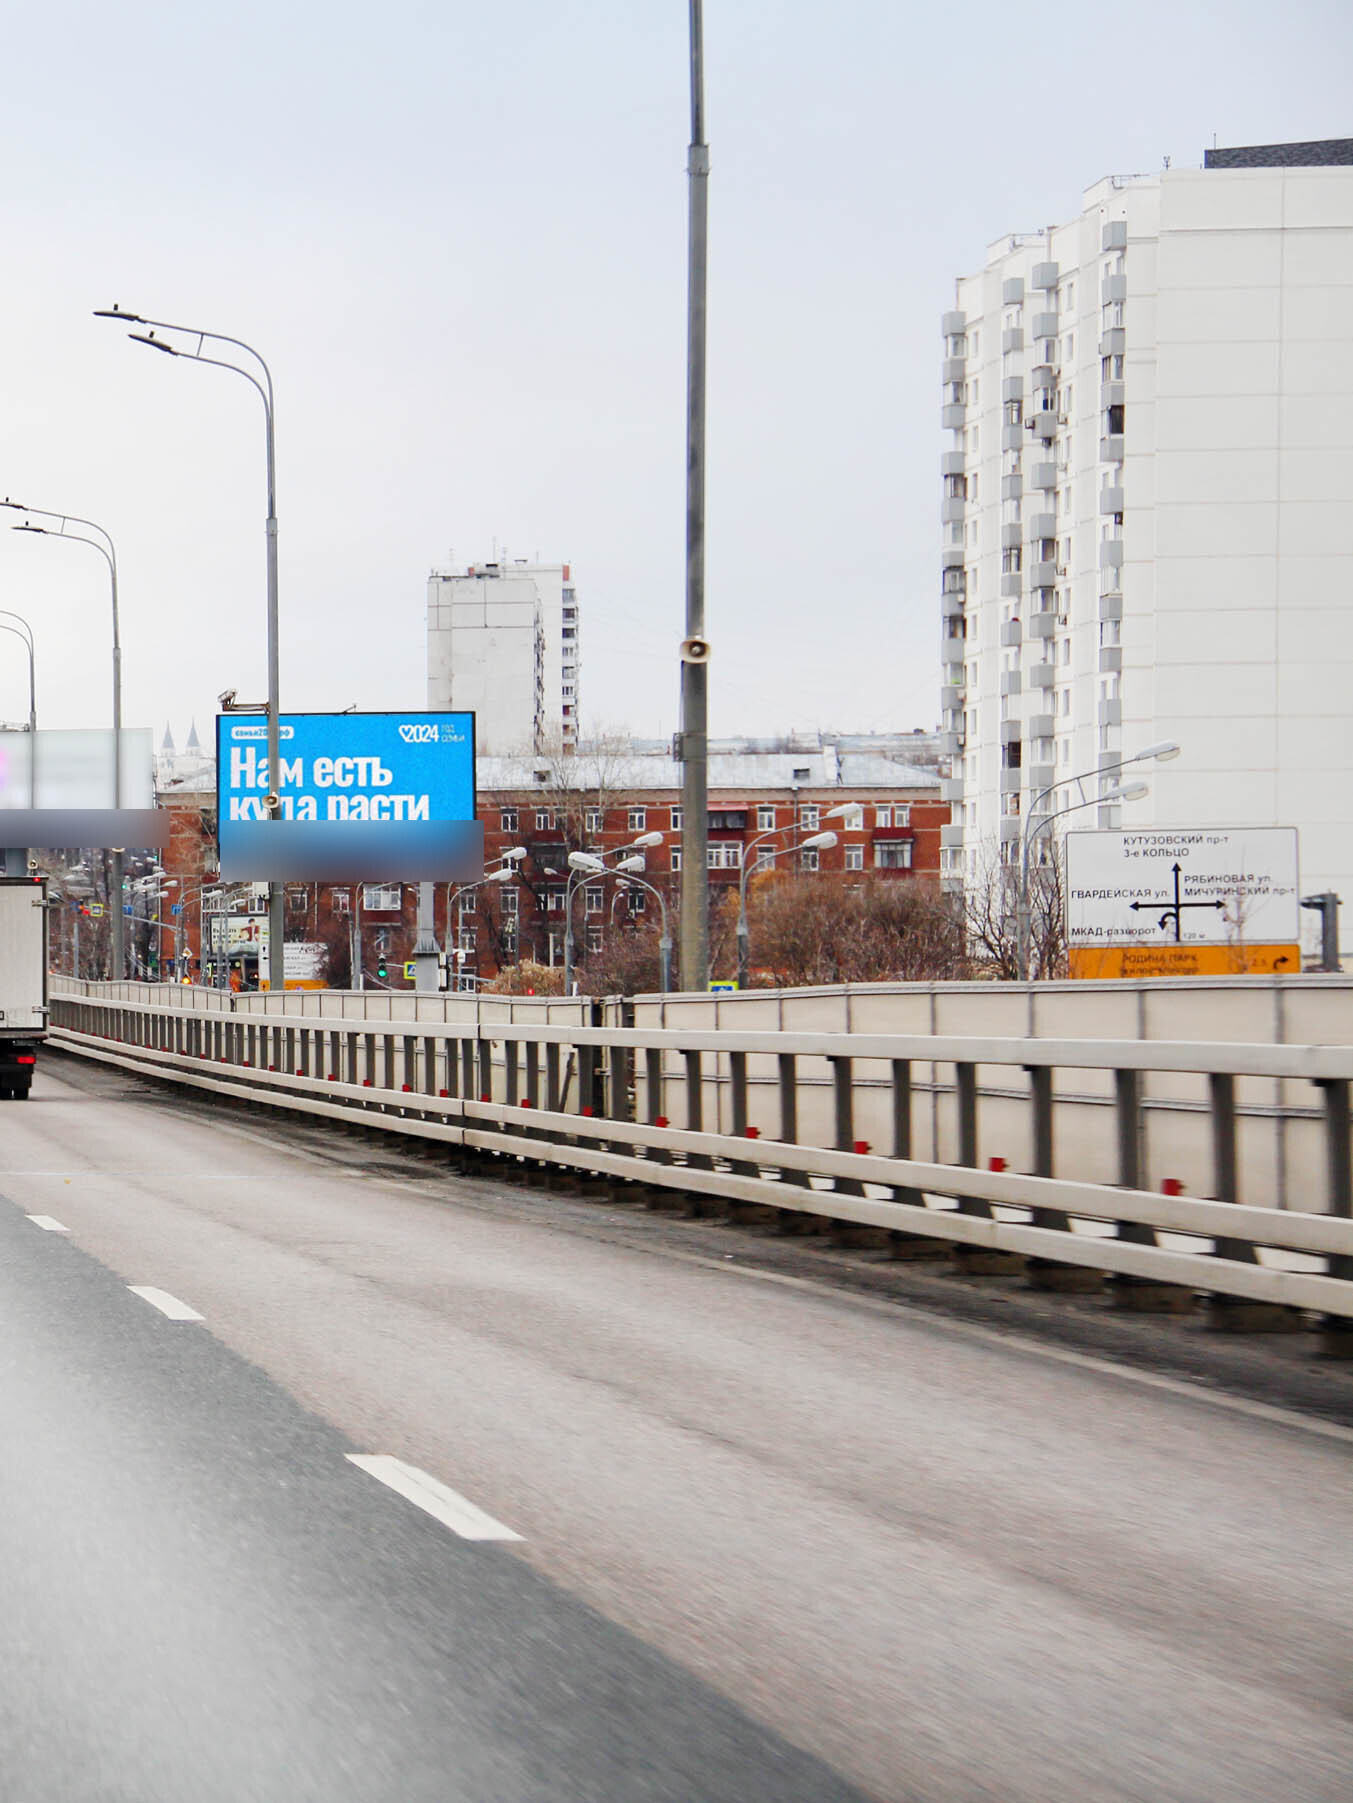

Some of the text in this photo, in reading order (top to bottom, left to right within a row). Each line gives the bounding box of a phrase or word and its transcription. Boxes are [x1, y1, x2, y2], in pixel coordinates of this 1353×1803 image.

[399, 724, 440, 743] 2024
[230, 747, 393, 788] Нам есть
[1123, 834, 1230, 846] КУТУЗОВСКИЙ пр-т
[1124, 847, 1190, 858] 3-е КОЛЬЦО
[1184, 873, 1255, 884] РЯБИНОВАЯ
[1071, 888, 1152, 899] ГВАРДЕЙСКАЯ
[1184, 886, 1269, 897] МИЧУРИНСКИЙ
